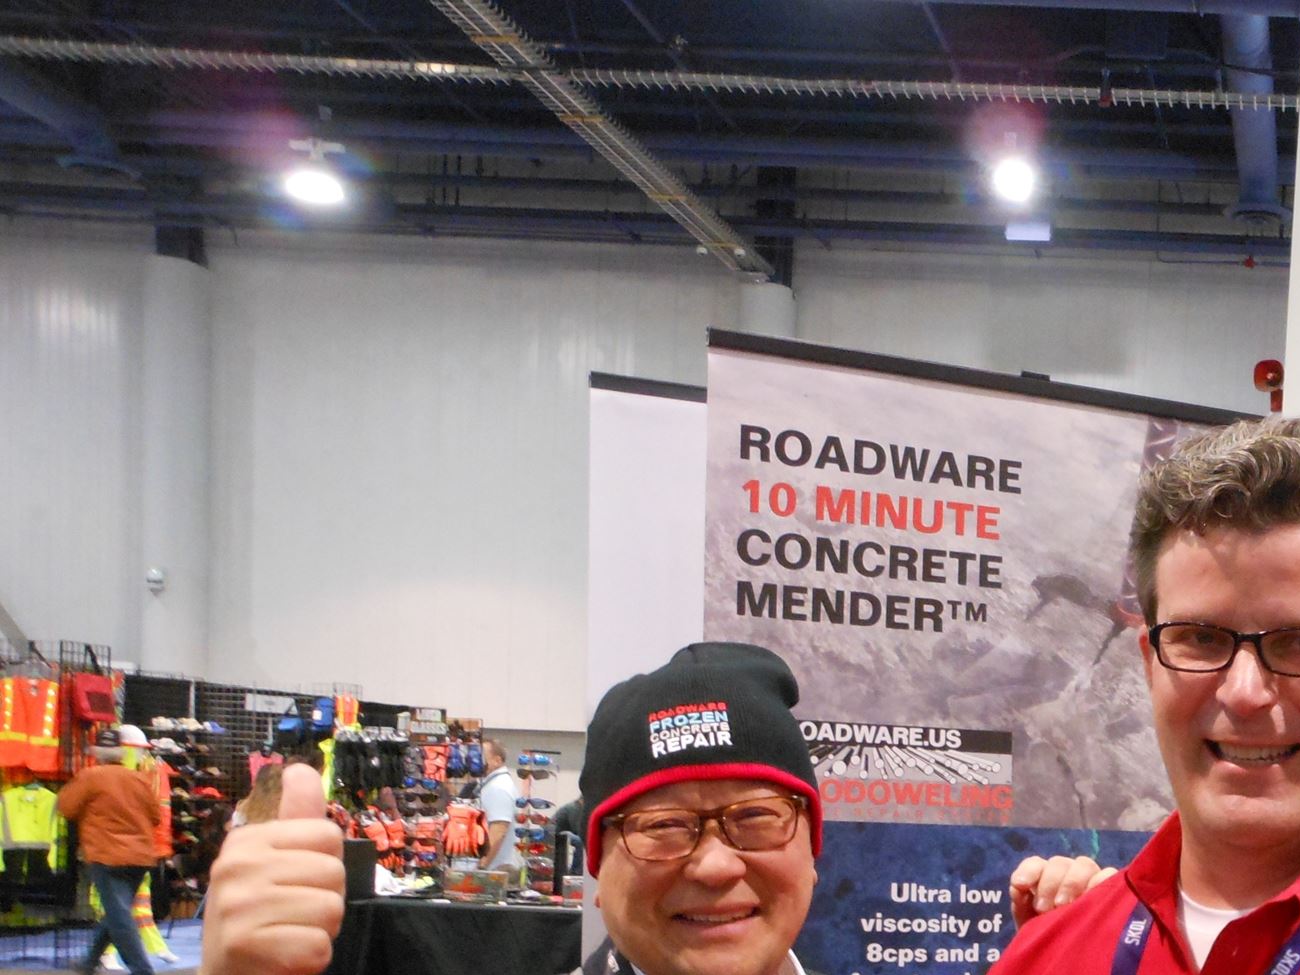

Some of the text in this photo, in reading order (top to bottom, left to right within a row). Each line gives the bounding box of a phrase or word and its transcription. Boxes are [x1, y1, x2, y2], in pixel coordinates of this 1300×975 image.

[740, 424, 1022, 494] ROADWARE
[742, 480, 1000, 540] 10 MINUTE
[737, 529, 1002, 589] CONCRETE
[650, 711, 728, 733] FROZEN
[650, 722, 730, 743] CONCRETE
[799, 720, 961, 749] OADWARE.US
[651, 731, 733, 758] REPAIR
[891, 883, 1002, 903] Ultra low
[861, 913, 1002, 937] viscosity of
[1125, 918, 1147, 946] SKOL
[866, 943, 1000, 967] 8cps and a
